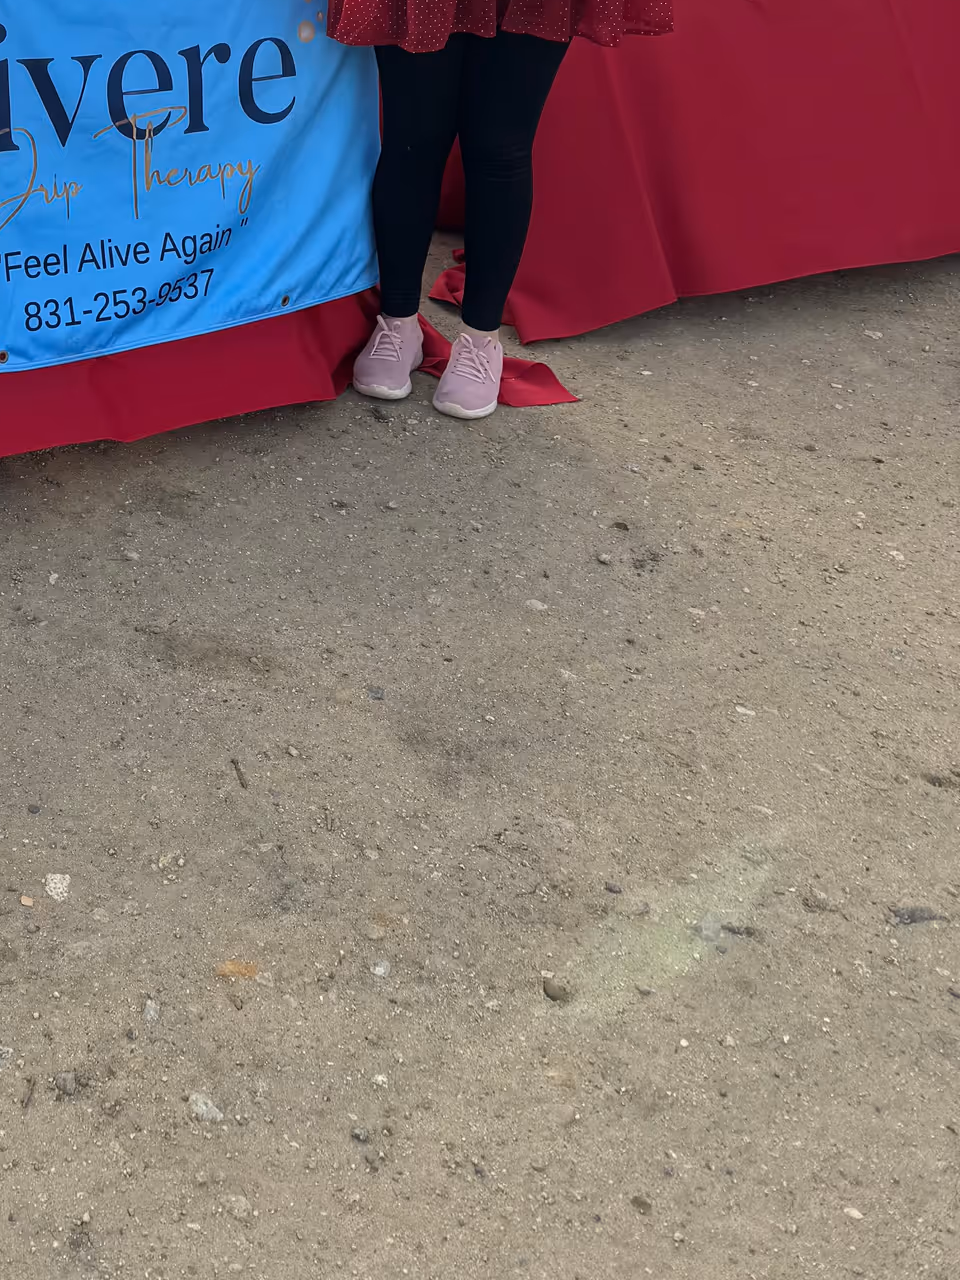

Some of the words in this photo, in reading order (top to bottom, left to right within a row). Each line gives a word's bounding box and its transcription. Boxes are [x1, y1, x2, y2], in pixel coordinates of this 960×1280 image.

[93, 106, 261, 219] Therapy
[78, 238, 150, 273] Alive
[24, 268, 214, 332] 831-253-9537
